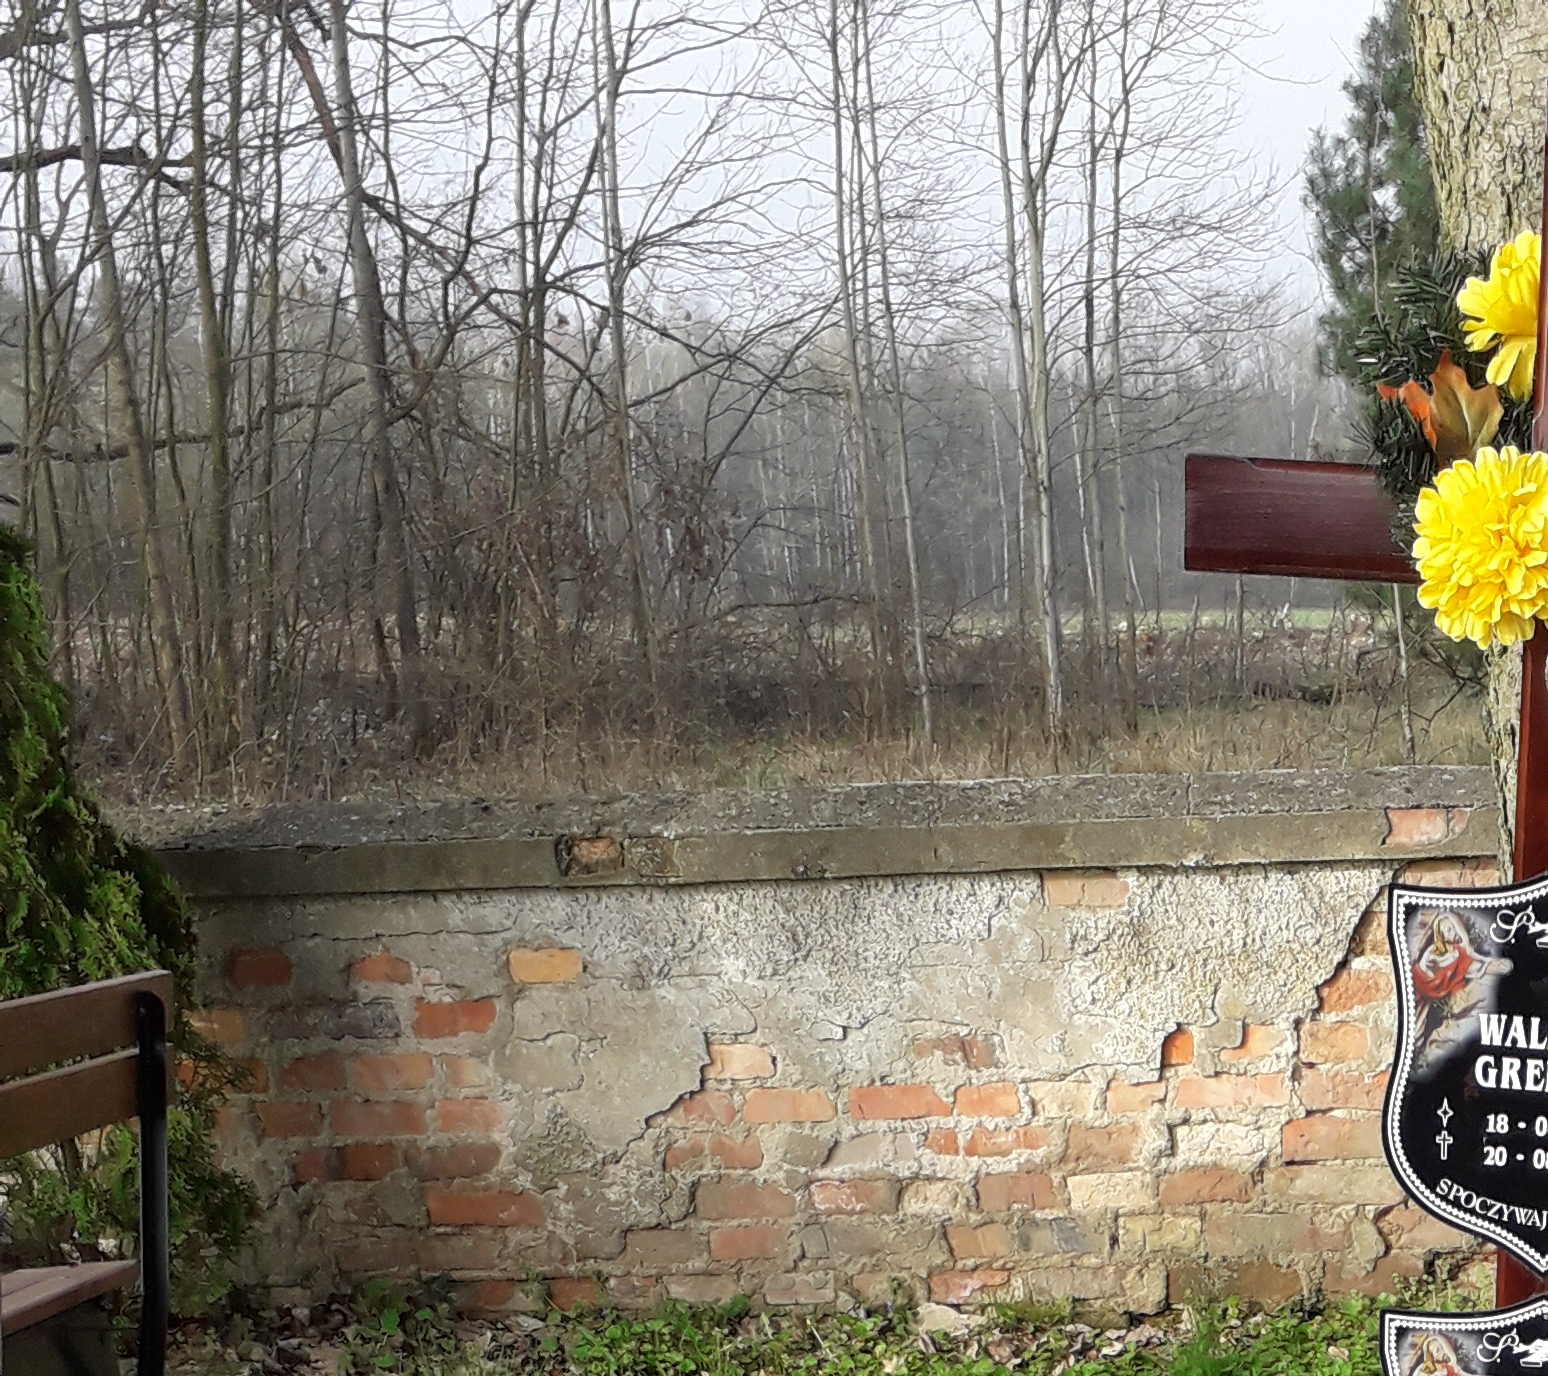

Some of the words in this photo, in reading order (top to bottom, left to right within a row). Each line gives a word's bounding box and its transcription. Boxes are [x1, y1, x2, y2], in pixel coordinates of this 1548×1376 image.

[1485, 1113, 1509, 1134] 18
[1483, 1146, 1508, 1167] 20
[1436, 1178, 1548, 1231] SPOCZYWAJ
